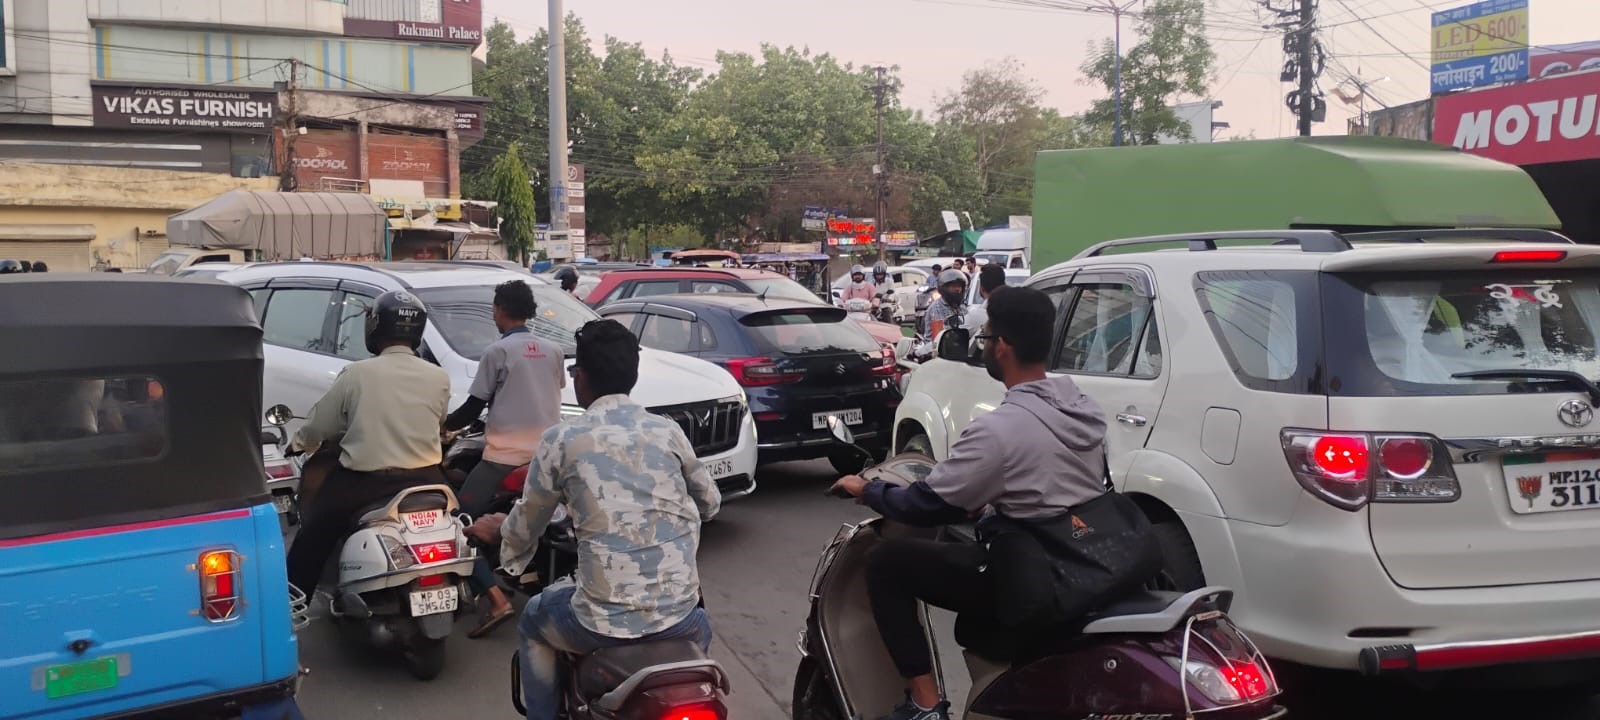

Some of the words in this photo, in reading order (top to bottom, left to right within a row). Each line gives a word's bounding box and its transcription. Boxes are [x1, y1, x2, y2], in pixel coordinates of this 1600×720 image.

[398, 23, 443, 38] Rukmani
[448, 26, 480, 39] Palace
[1436, 23, 1481, 48] LED
[1488, 15, 1526, 41] 600/-
[1490, 52, 1525, 74] 200/-
[1433, 63, 1485, 86] ग्लोसाइन
[135, 88, 190, 97] AUTHORISED
[193, 91, 250, 99] WHOLESALER
[103, 95, 174, 115] VIKAS
[180, 99, 272, 118] FURNISH
[131, 116, 170, 125] Exclusive
[222, 120, 265, 128] showroom
[1452, 94, 1600, 150] MOTU
[399, 308, 418, 317] NAVY
[1550, 484, 1600, 507] 311
[409, 511, 437, 520] INDIAN
[413, 519, 435, 527] NAVY
[421, 591, 432, 601] MP
[437, 590, 451, 600] 09
